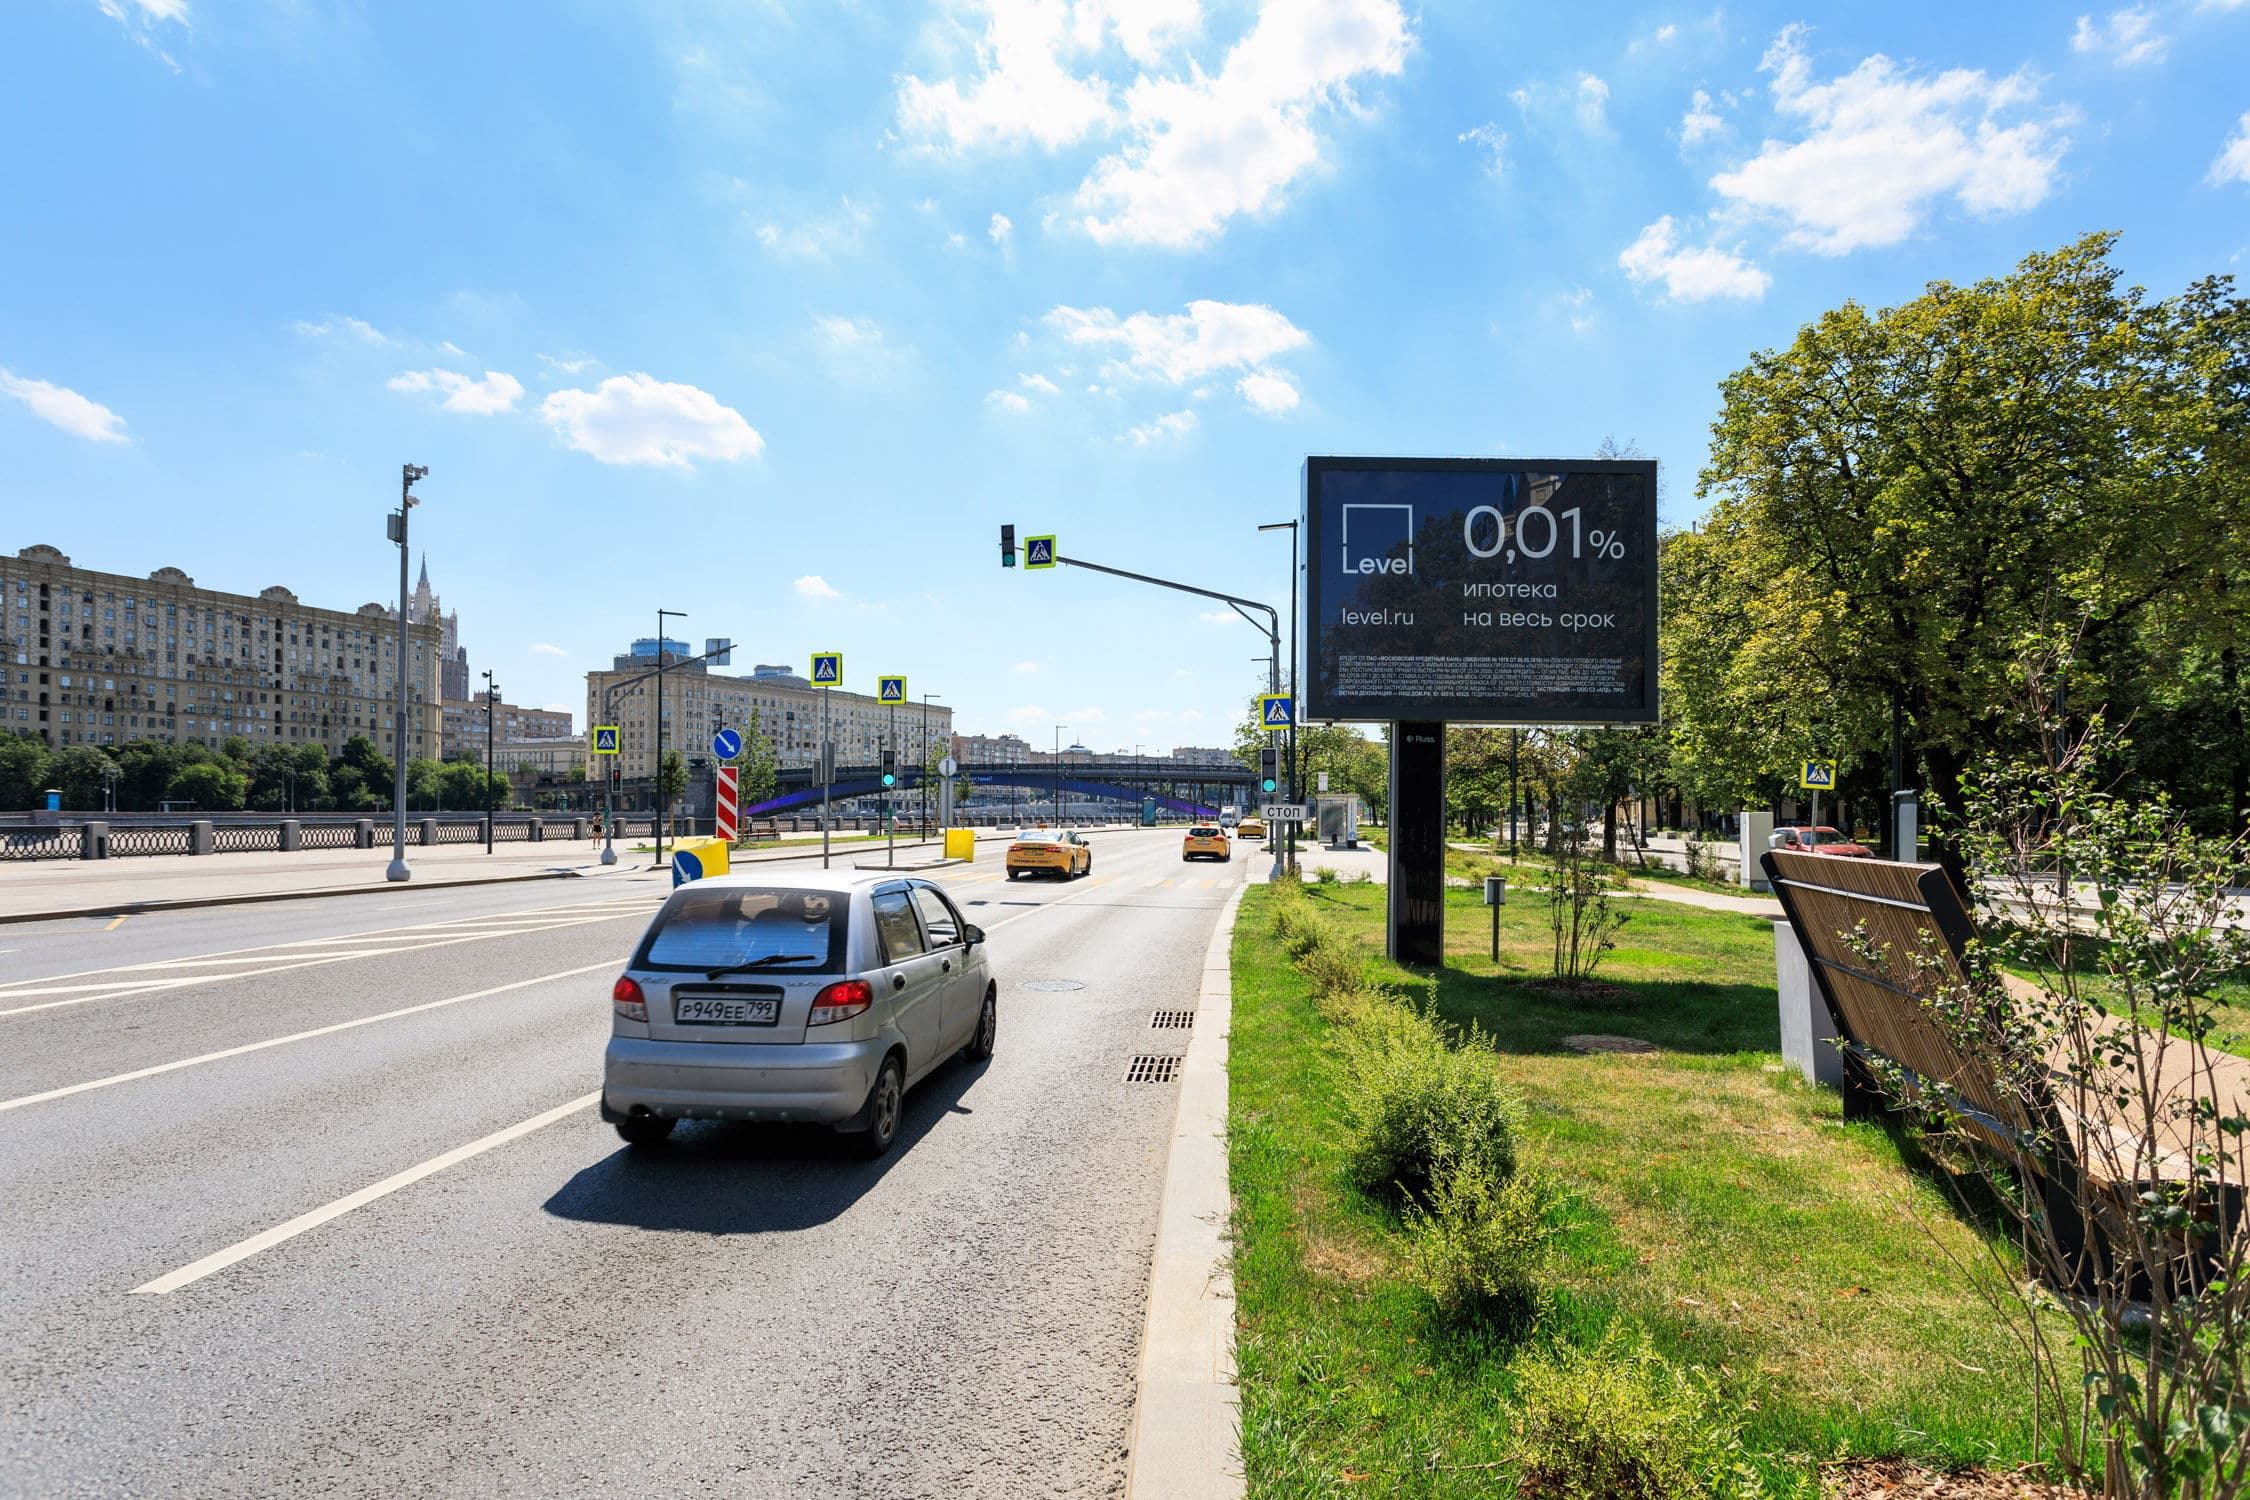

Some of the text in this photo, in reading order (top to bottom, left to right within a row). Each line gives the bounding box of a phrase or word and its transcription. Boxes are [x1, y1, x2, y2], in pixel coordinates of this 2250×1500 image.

[1464, 505, 1625, 564] 0,01%
[1342, 546, 1413, 575] Level
[1464, 583, 1557, 598] ипотека
[1342, 607, 1414, 626] level.ru
[1464, 612, 1615, 633] на весь срок
[1267, 807, 1300, 818] СТОП
[748, 1002, 772, 1015] 799
